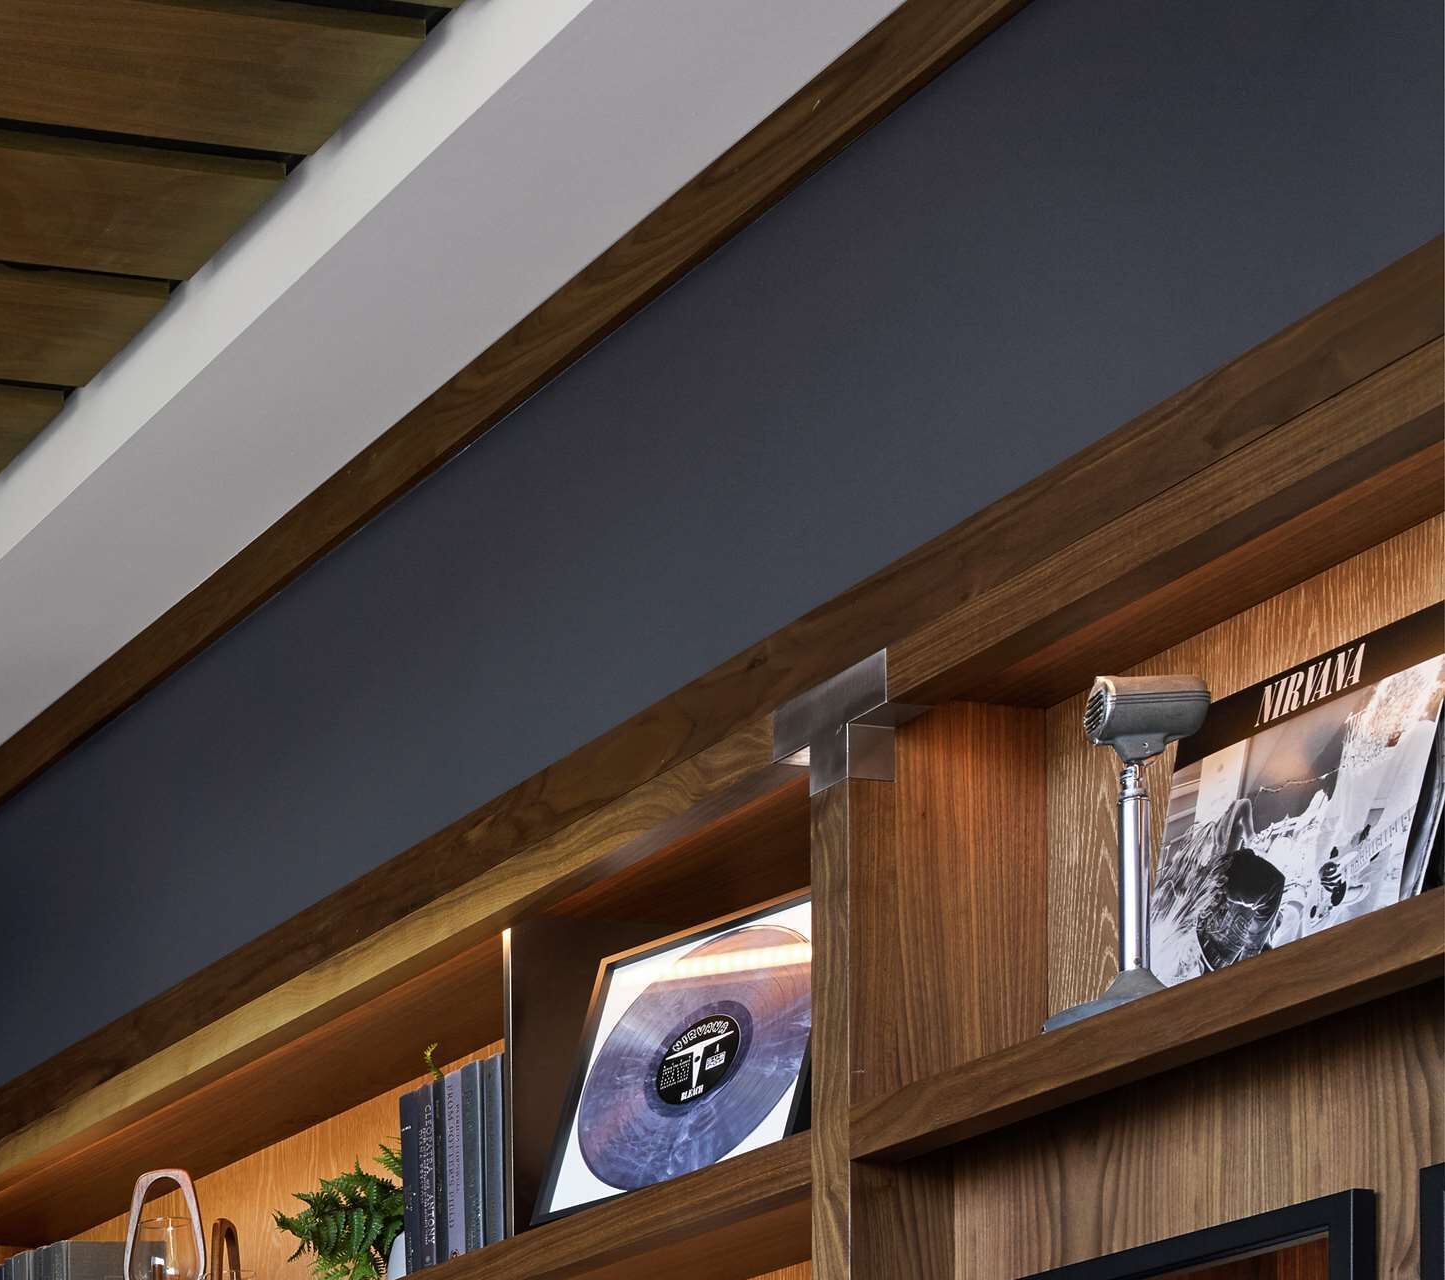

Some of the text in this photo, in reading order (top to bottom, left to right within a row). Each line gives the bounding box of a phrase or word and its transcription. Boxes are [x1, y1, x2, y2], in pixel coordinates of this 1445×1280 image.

[1254, 643, 1365, 728] NIRVANA
[672, 1021, 729, 1052] NIRVANA
[426, 1194, 436, 1244] ANTONY
